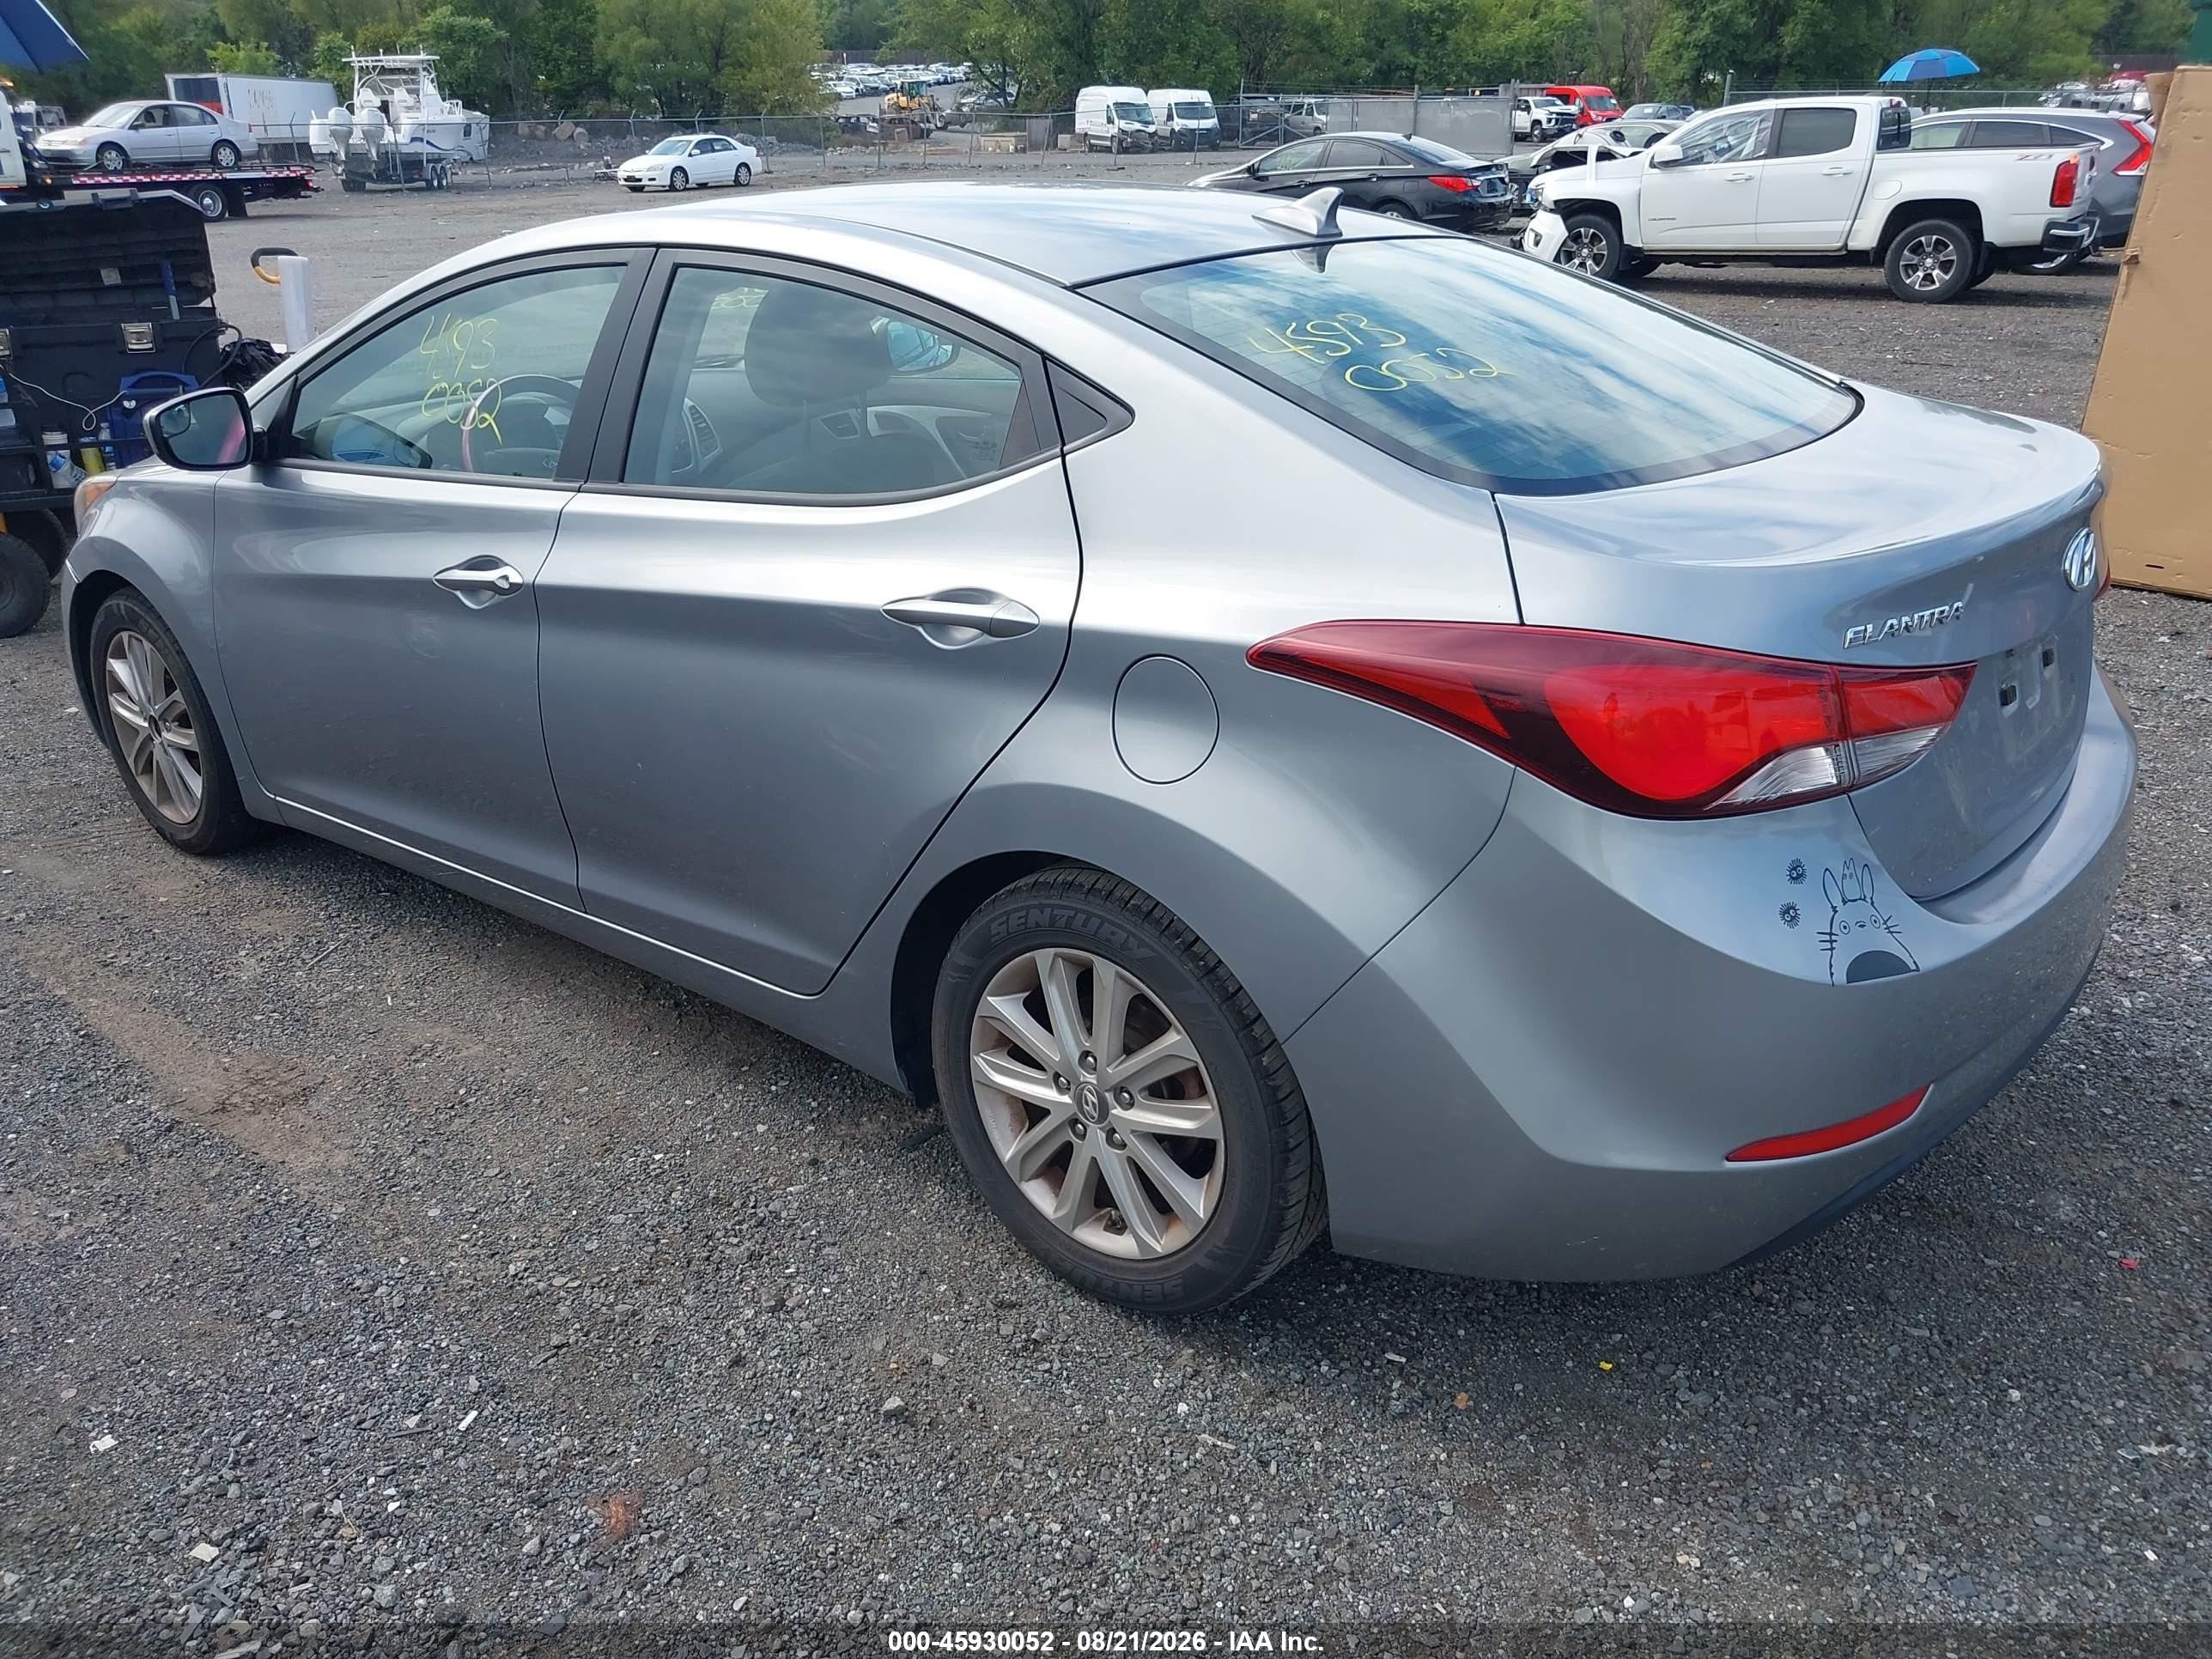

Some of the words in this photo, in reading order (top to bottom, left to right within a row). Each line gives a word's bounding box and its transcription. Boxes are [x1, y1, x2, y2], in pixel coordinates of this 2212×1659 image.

[1247, 313, 1407, 365] 4593
[1344, 347, 1518, 392] 0052
[1844, 600, 1965, 649] ELANTRA
[990, 907, 1158, 961] SENTURY
